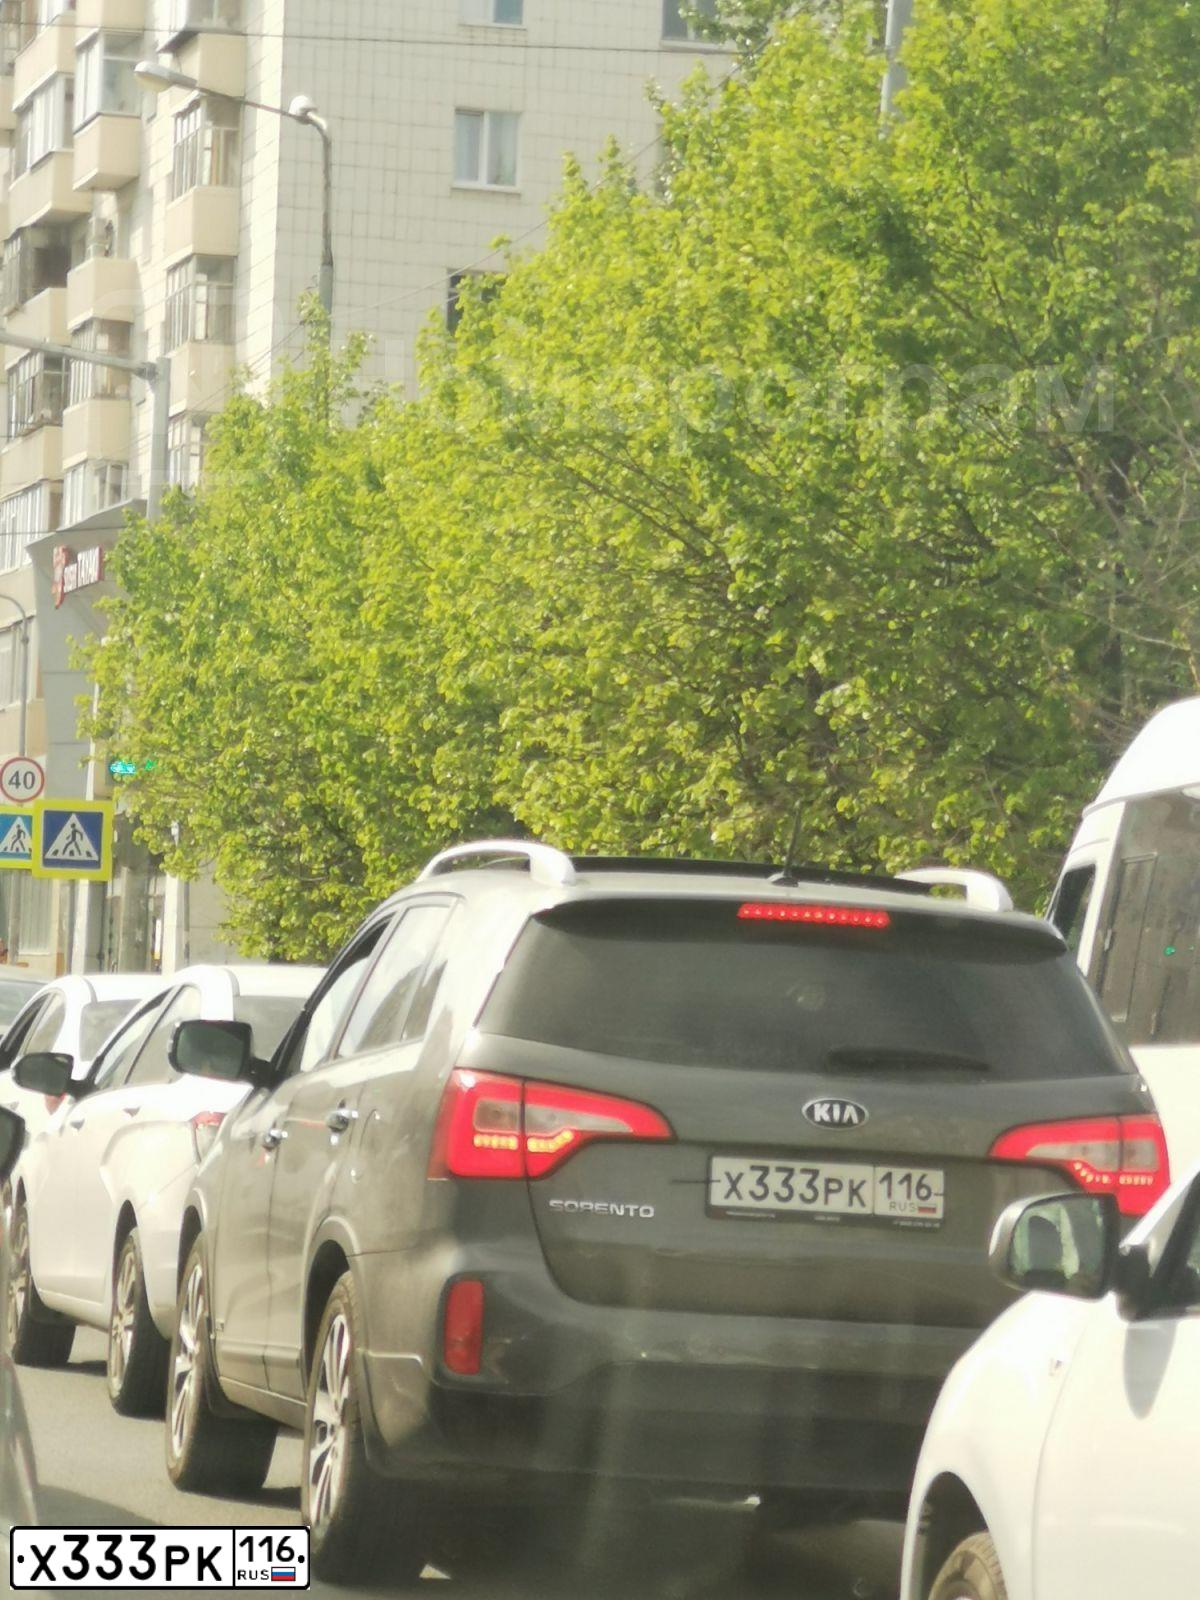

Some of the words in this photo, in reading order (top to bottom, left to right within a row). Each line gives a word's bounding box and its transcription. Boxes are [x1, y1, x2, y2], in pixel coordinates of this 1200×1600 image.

[8, 770, 36, 790] 40
[813, 1102, 859, 1125] KIA
[878, 1171, 933, 1201] 116
[549, 1199, 655, 1219] SORENTO
[889, 1201, 917, 1213] RUS
